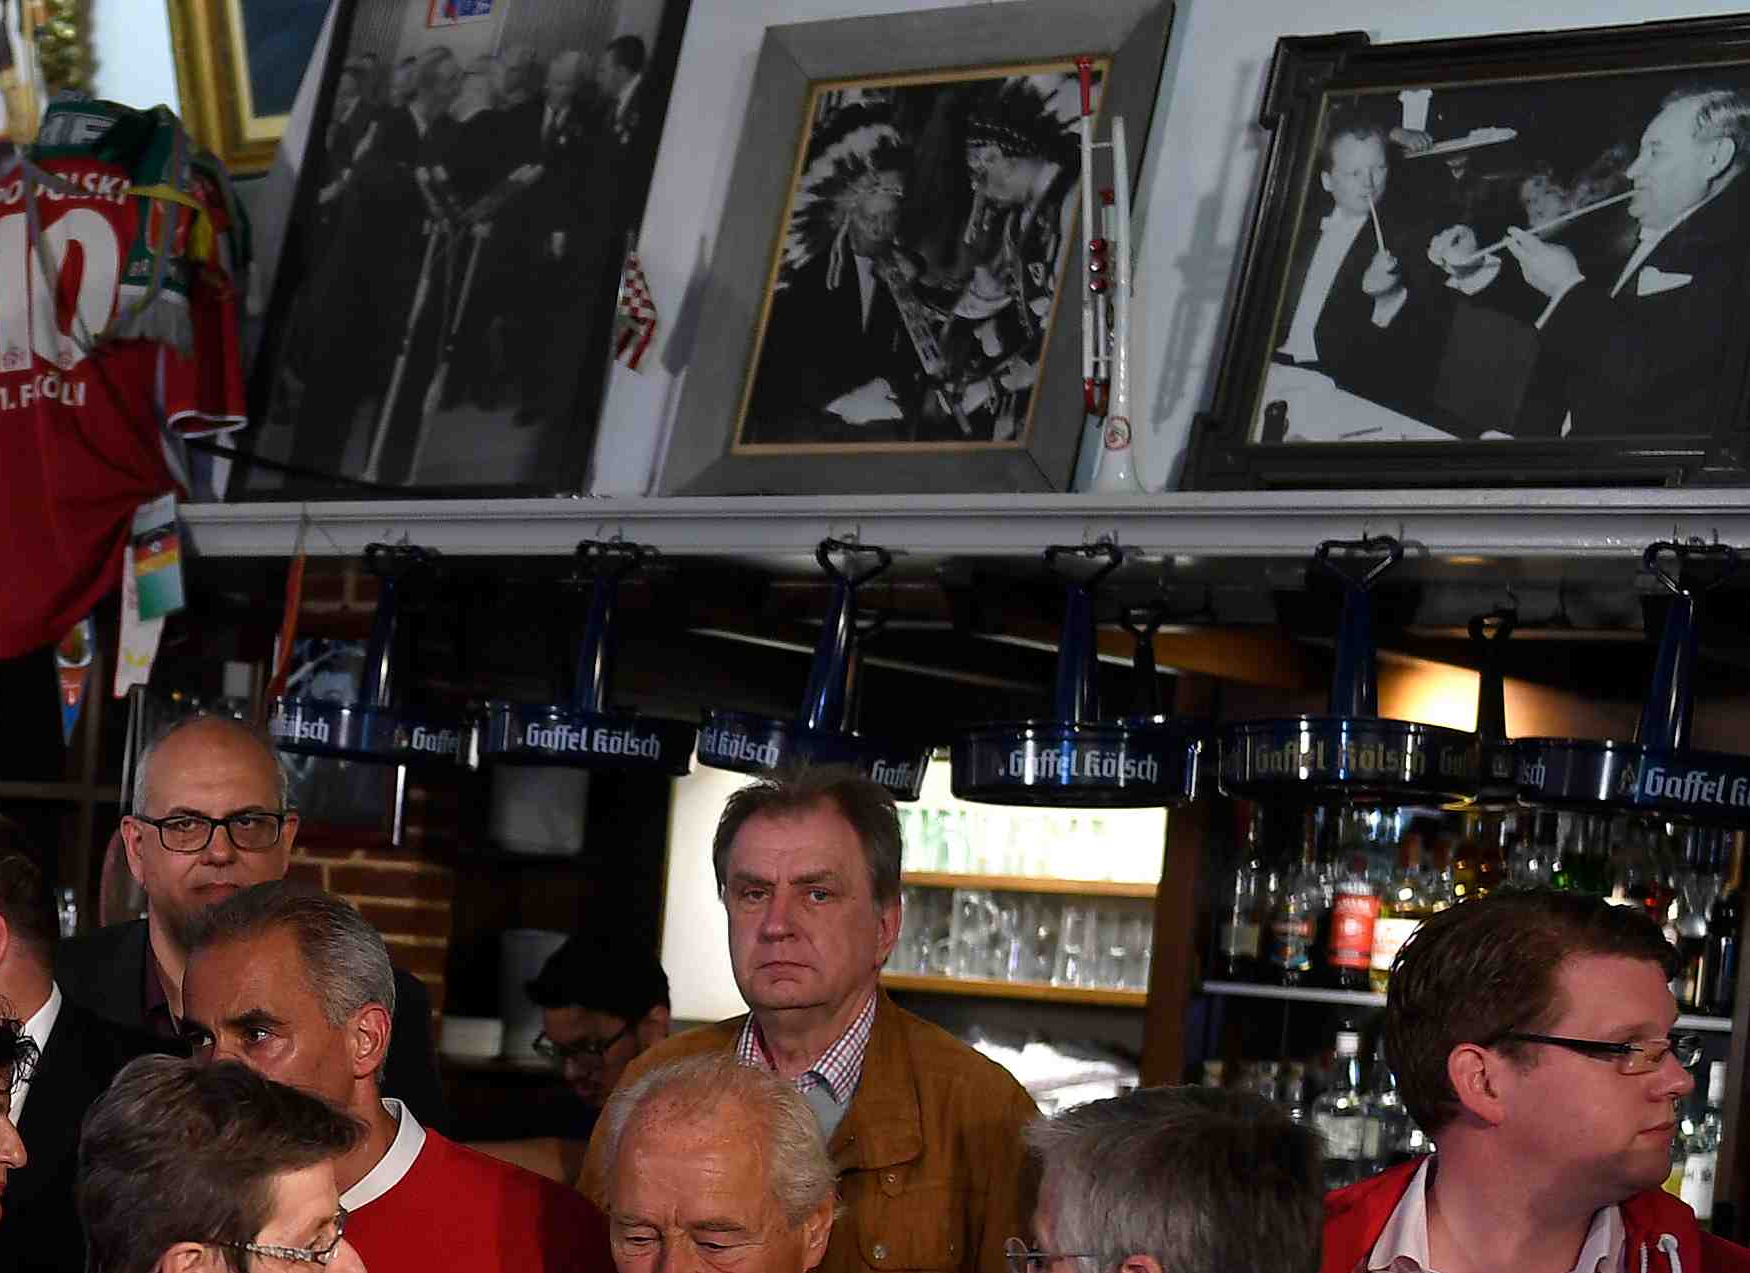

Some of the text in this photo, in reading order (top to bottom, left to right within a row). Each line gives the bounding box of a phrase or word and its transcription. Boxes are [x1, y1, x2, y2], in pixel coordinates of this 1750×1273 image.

[525, 723, 662, 761] Gaffel Kölsch
[716, 731, 781, 769] Kölsch
[1008, 748, 1159, 786] Gaffel Kölsch
[1645, 767, 1726, 806] Gaffel
